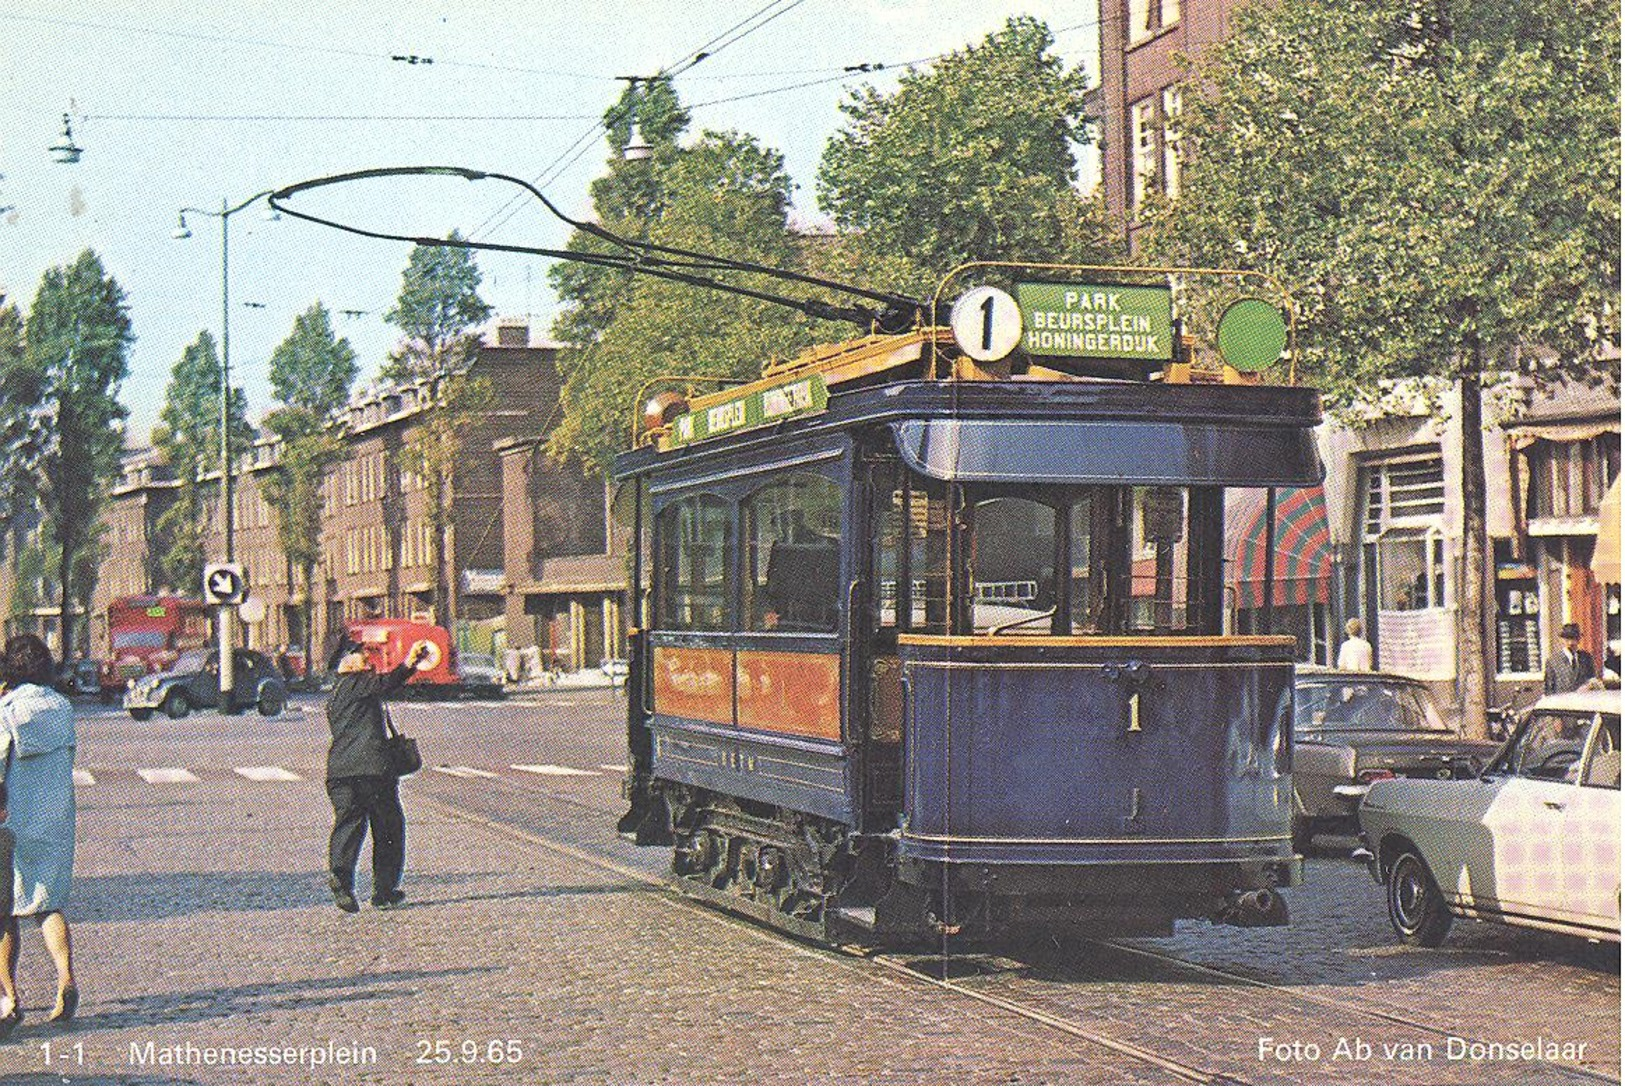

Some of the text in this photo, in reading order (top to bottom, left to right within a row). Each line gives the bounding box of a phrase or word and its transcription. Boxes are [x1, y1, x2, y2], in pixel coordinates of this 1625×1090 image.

[1064, 290, 1121, 312] PARK
[980, 296, 996, 351] 1
[1033, 311, 1151, 333] BEURSPLEIN
[1127, 693, 1142, 732] 1
